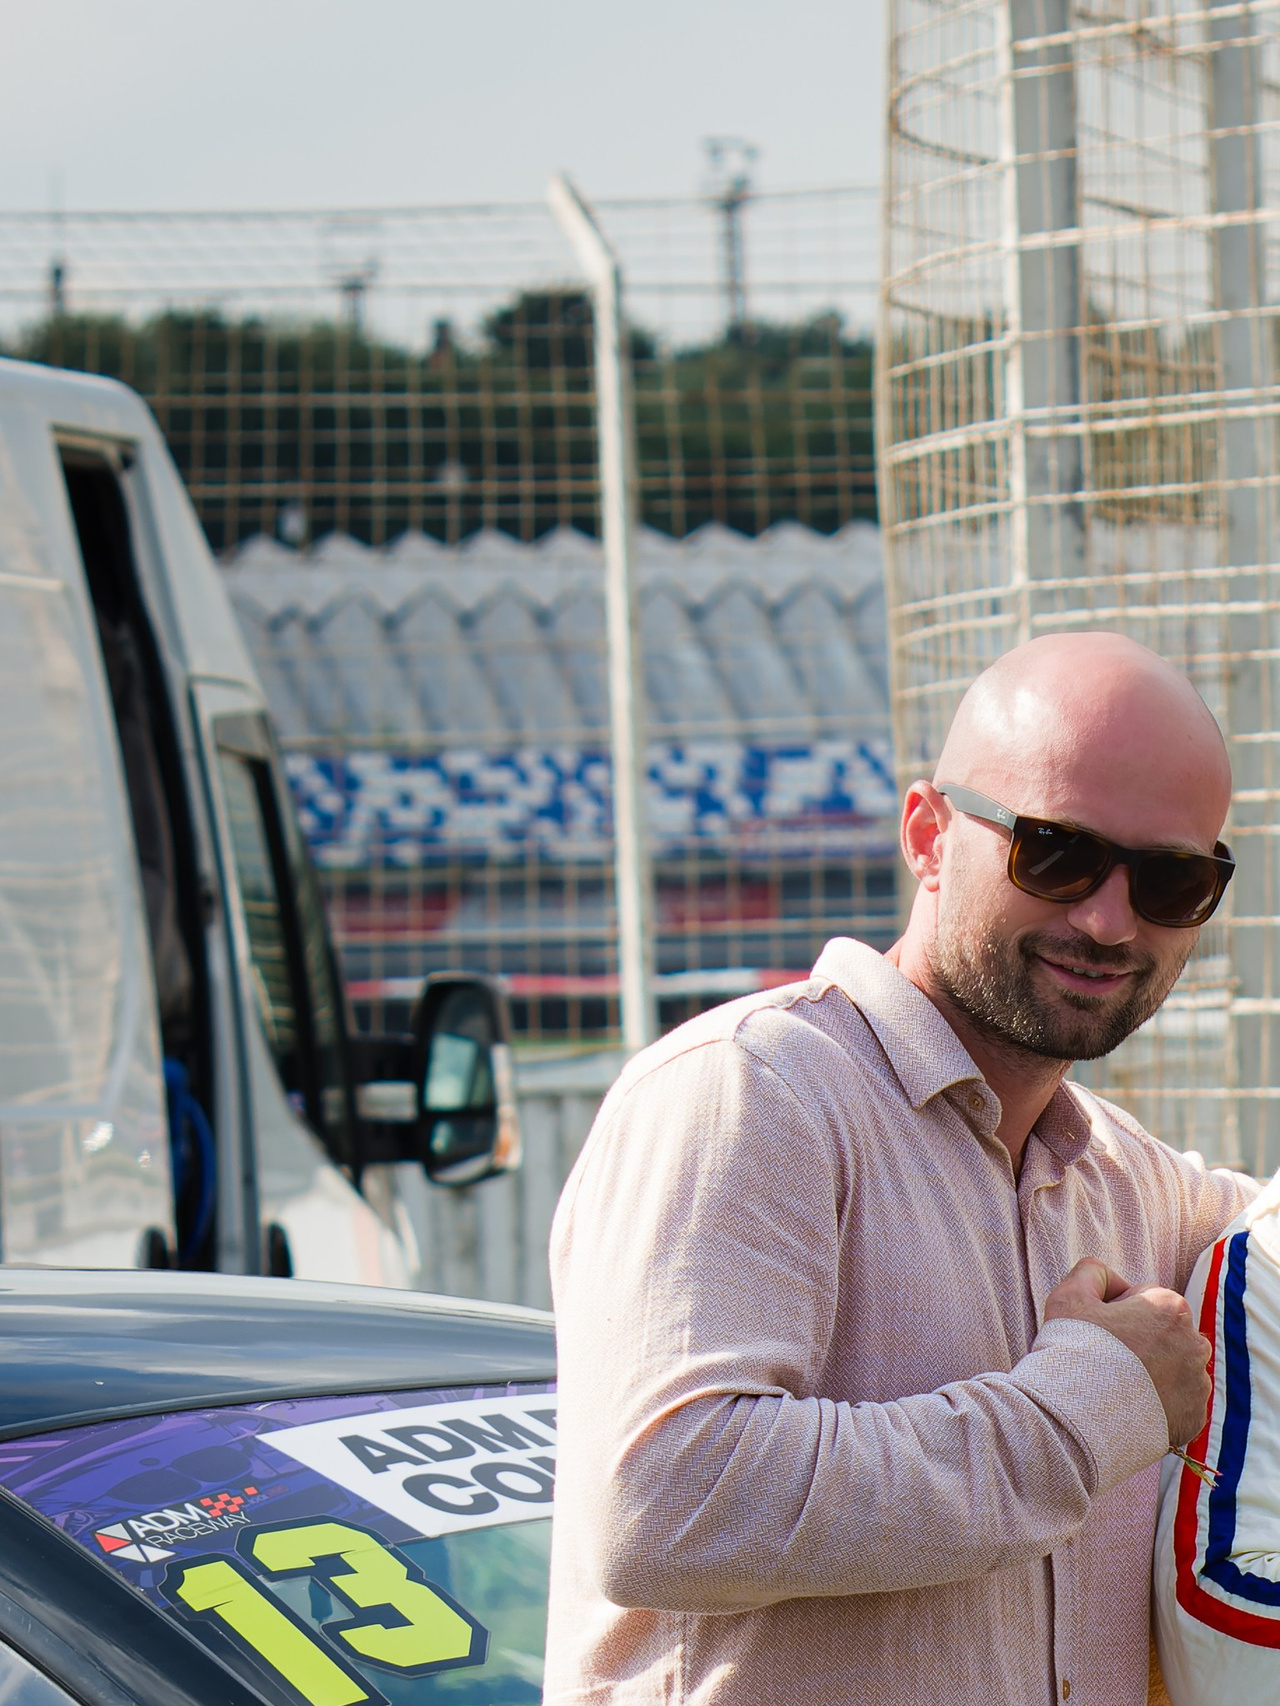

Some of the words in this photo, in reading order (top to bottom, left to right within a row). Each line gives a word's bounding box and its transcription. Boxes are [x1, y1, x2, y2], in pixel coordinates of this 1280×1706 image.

[338, 1413, 556, 1475] ADM
[402, 1455, 557, 1516] CO
[127, 1503, 213, 1539] ADM
[145, 1511, 252, 1548] RACEWAY
